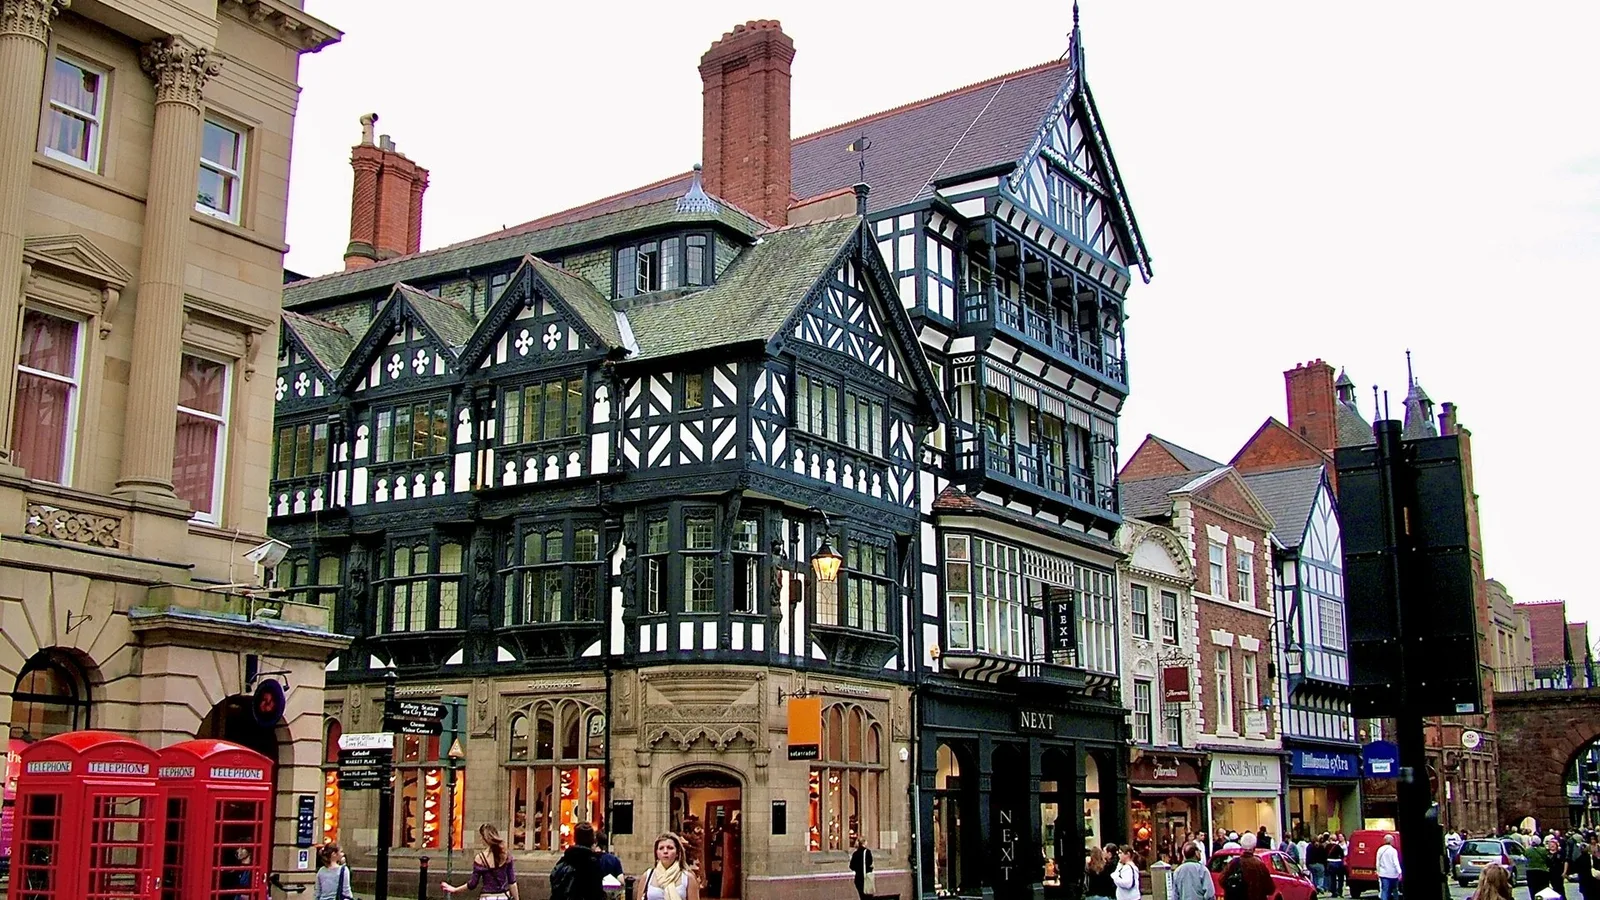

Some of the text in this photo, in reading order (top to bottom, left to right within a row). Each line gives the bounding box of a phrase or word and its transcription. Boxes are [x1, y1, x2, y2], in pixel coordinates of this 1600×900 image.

[1058, 603, 1069, 648] NEXT
[400, 702, 439, 712] Railway Station
[410, 708, 421, 717] City
[1020, 711, 1054, 730] NEXT
[29, 762, 71, 773] TELEPHONE
[91, 763, 146, 773] TELEPHONE
[1220, 759, 1242, 776] Russell
[213, 768, 262, 779] TELEPHONE
[1000, 809, 1013, 881] NEXT
